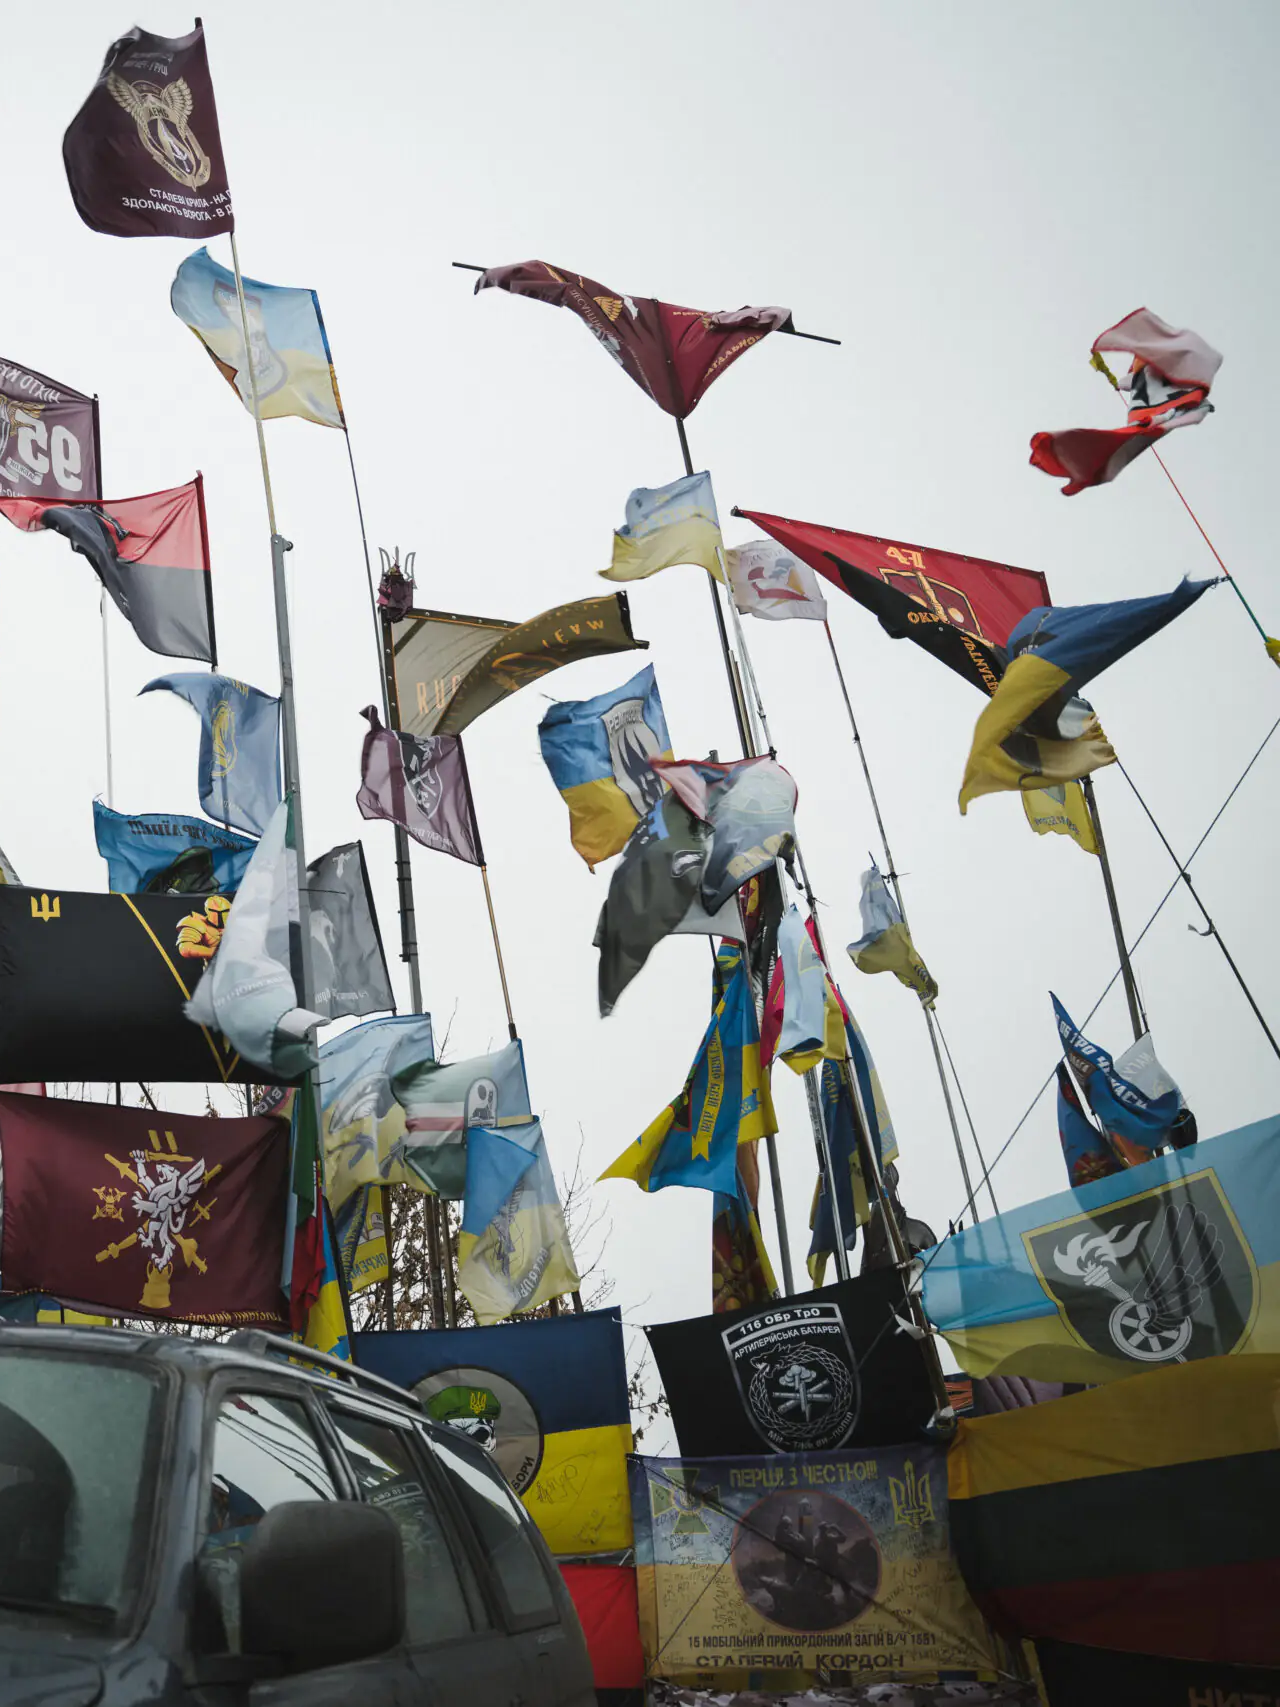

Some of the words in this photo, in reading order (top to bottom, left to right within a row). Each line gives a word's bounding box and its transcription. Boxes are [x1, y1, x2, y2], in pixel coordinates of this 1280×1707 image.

[122, 197, 182, 216] ЗДОЛАЮТЬ
[182, 204, 211, 221] ВОРОГА
[739, 1319, 762, 1336] 116
[764, 1312, 791, 1326] ОБр
[793, 1307, 821, 1320] ТрО
[733, 1329, 800, 1361] АРТИЛЕРІЙСЬКА
[800, 1325, 842, 1336] БАТАРЕЯ
[702, 1633, 766, 1649] МОБІЛЬНИЙ
[766, 1632, 853, 1649] ПРИКОРДОННИЙ
[853, 1632, 886, 1647] ЗАГІН
[815, 1653, 905, 1672] КОРДОН
